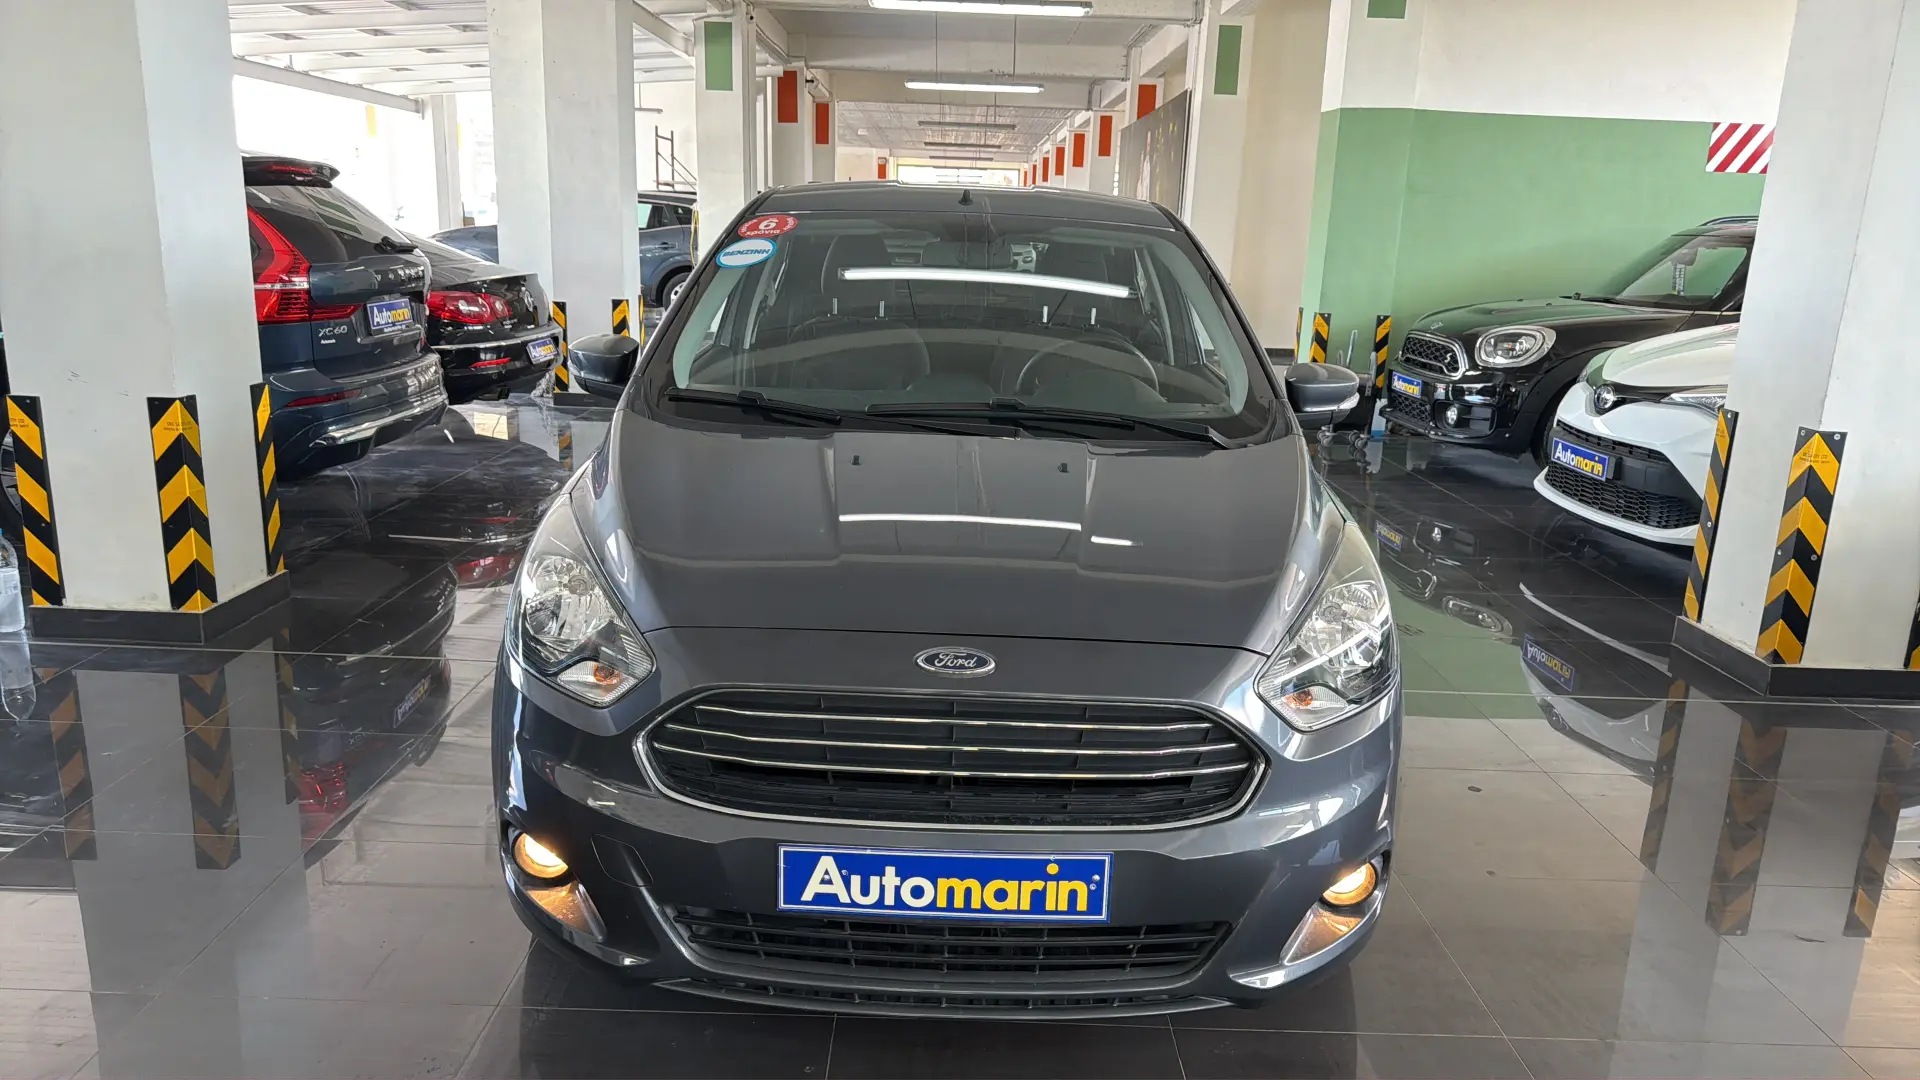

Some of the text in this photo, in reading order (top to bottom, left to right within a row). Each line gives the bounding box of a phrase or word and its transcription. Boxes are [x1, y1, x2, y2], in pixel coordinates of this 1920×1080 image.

[759, 218, 778, 229] 6
[373, 302, 412, 326] Automarin
[318, 325, 348, 337] XC60
[1554, 442, 1603, 477] Automarin
[934, 652, 978, 668] Ford
[800, 855, 1088, 912] Automarin
